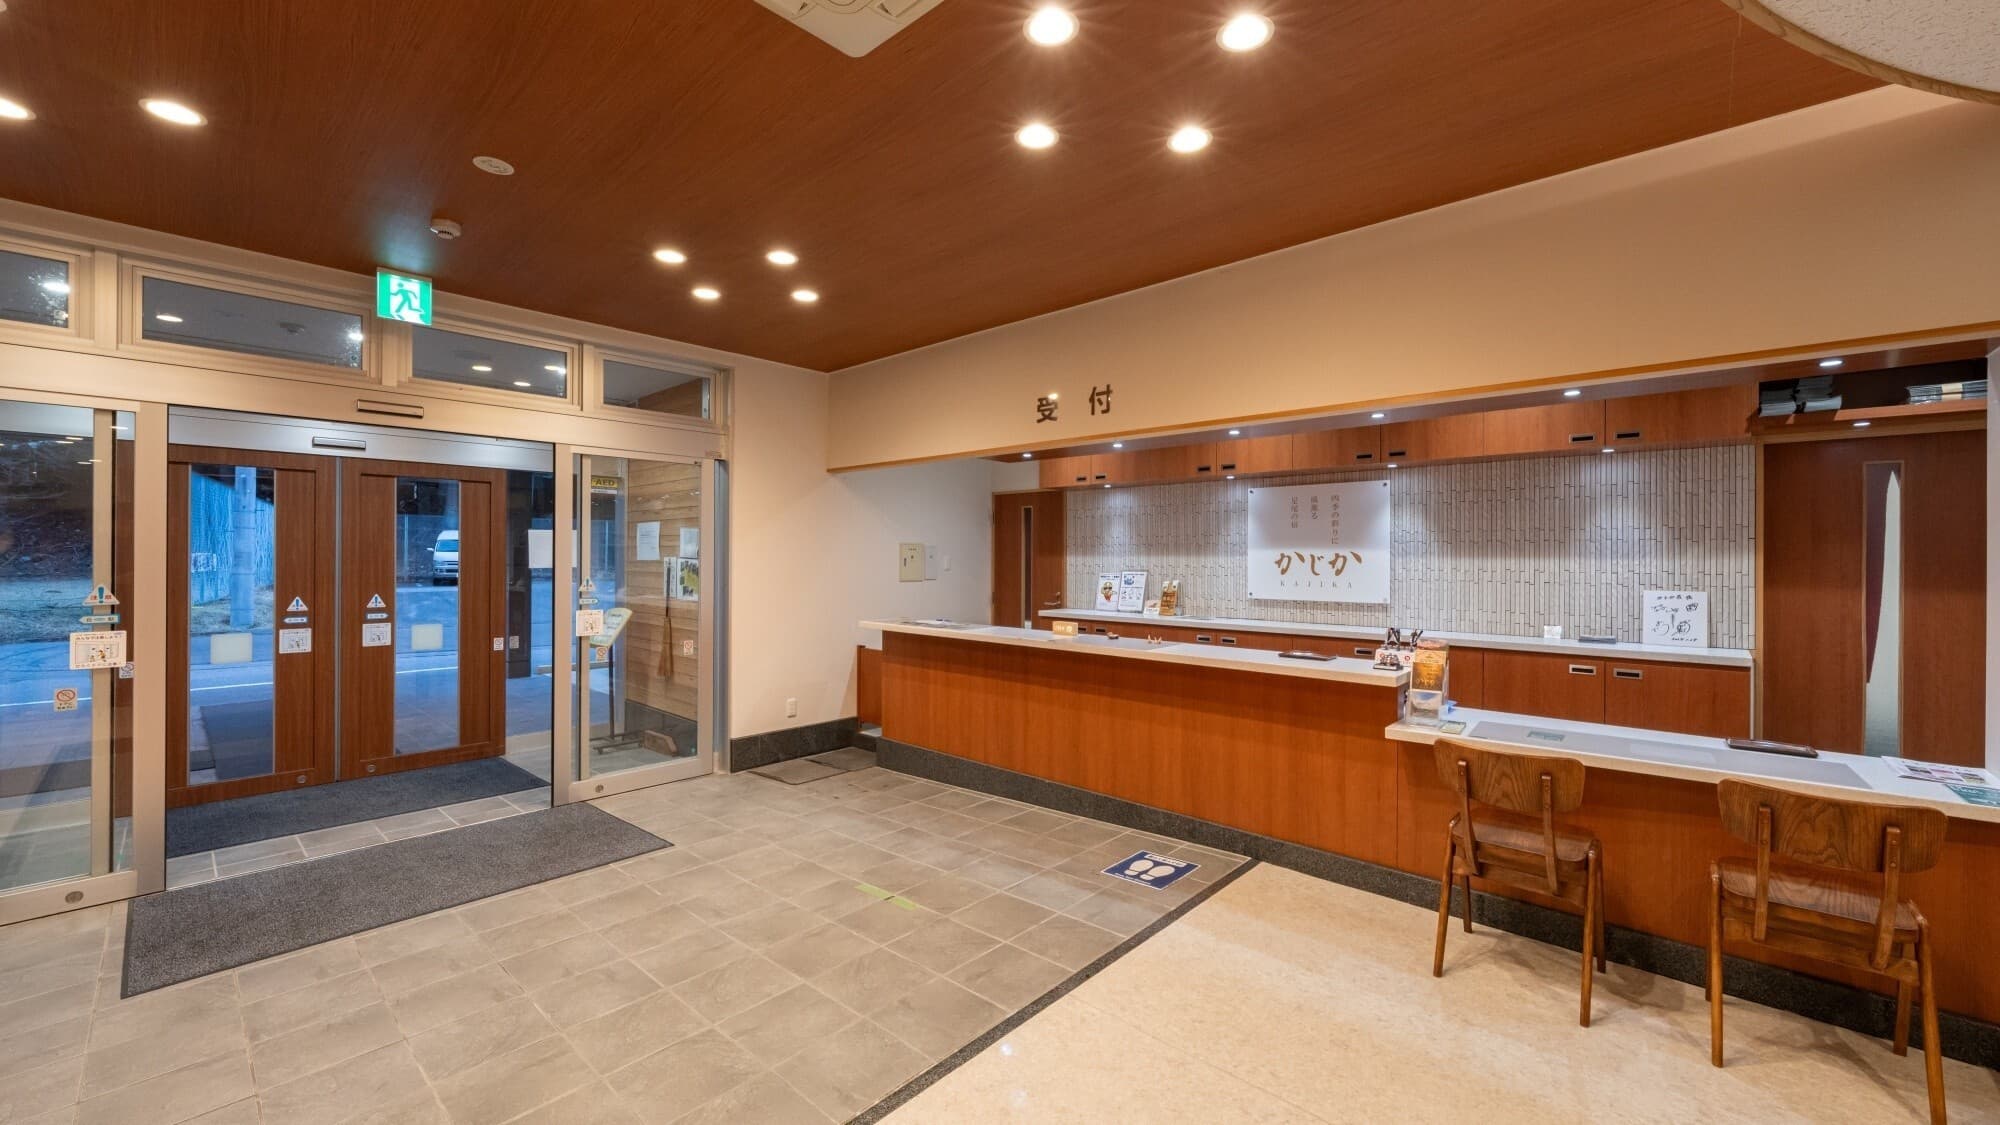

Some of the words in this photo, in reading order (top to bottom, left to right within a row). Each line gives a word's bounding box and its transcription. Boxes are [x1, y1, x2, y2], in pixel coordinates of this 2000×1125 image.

[1036, 384, 1113, 424] 受付
[1274, 551, 1363, 577] かじか
[1280, 581, 1352, 589] KAJIKA
